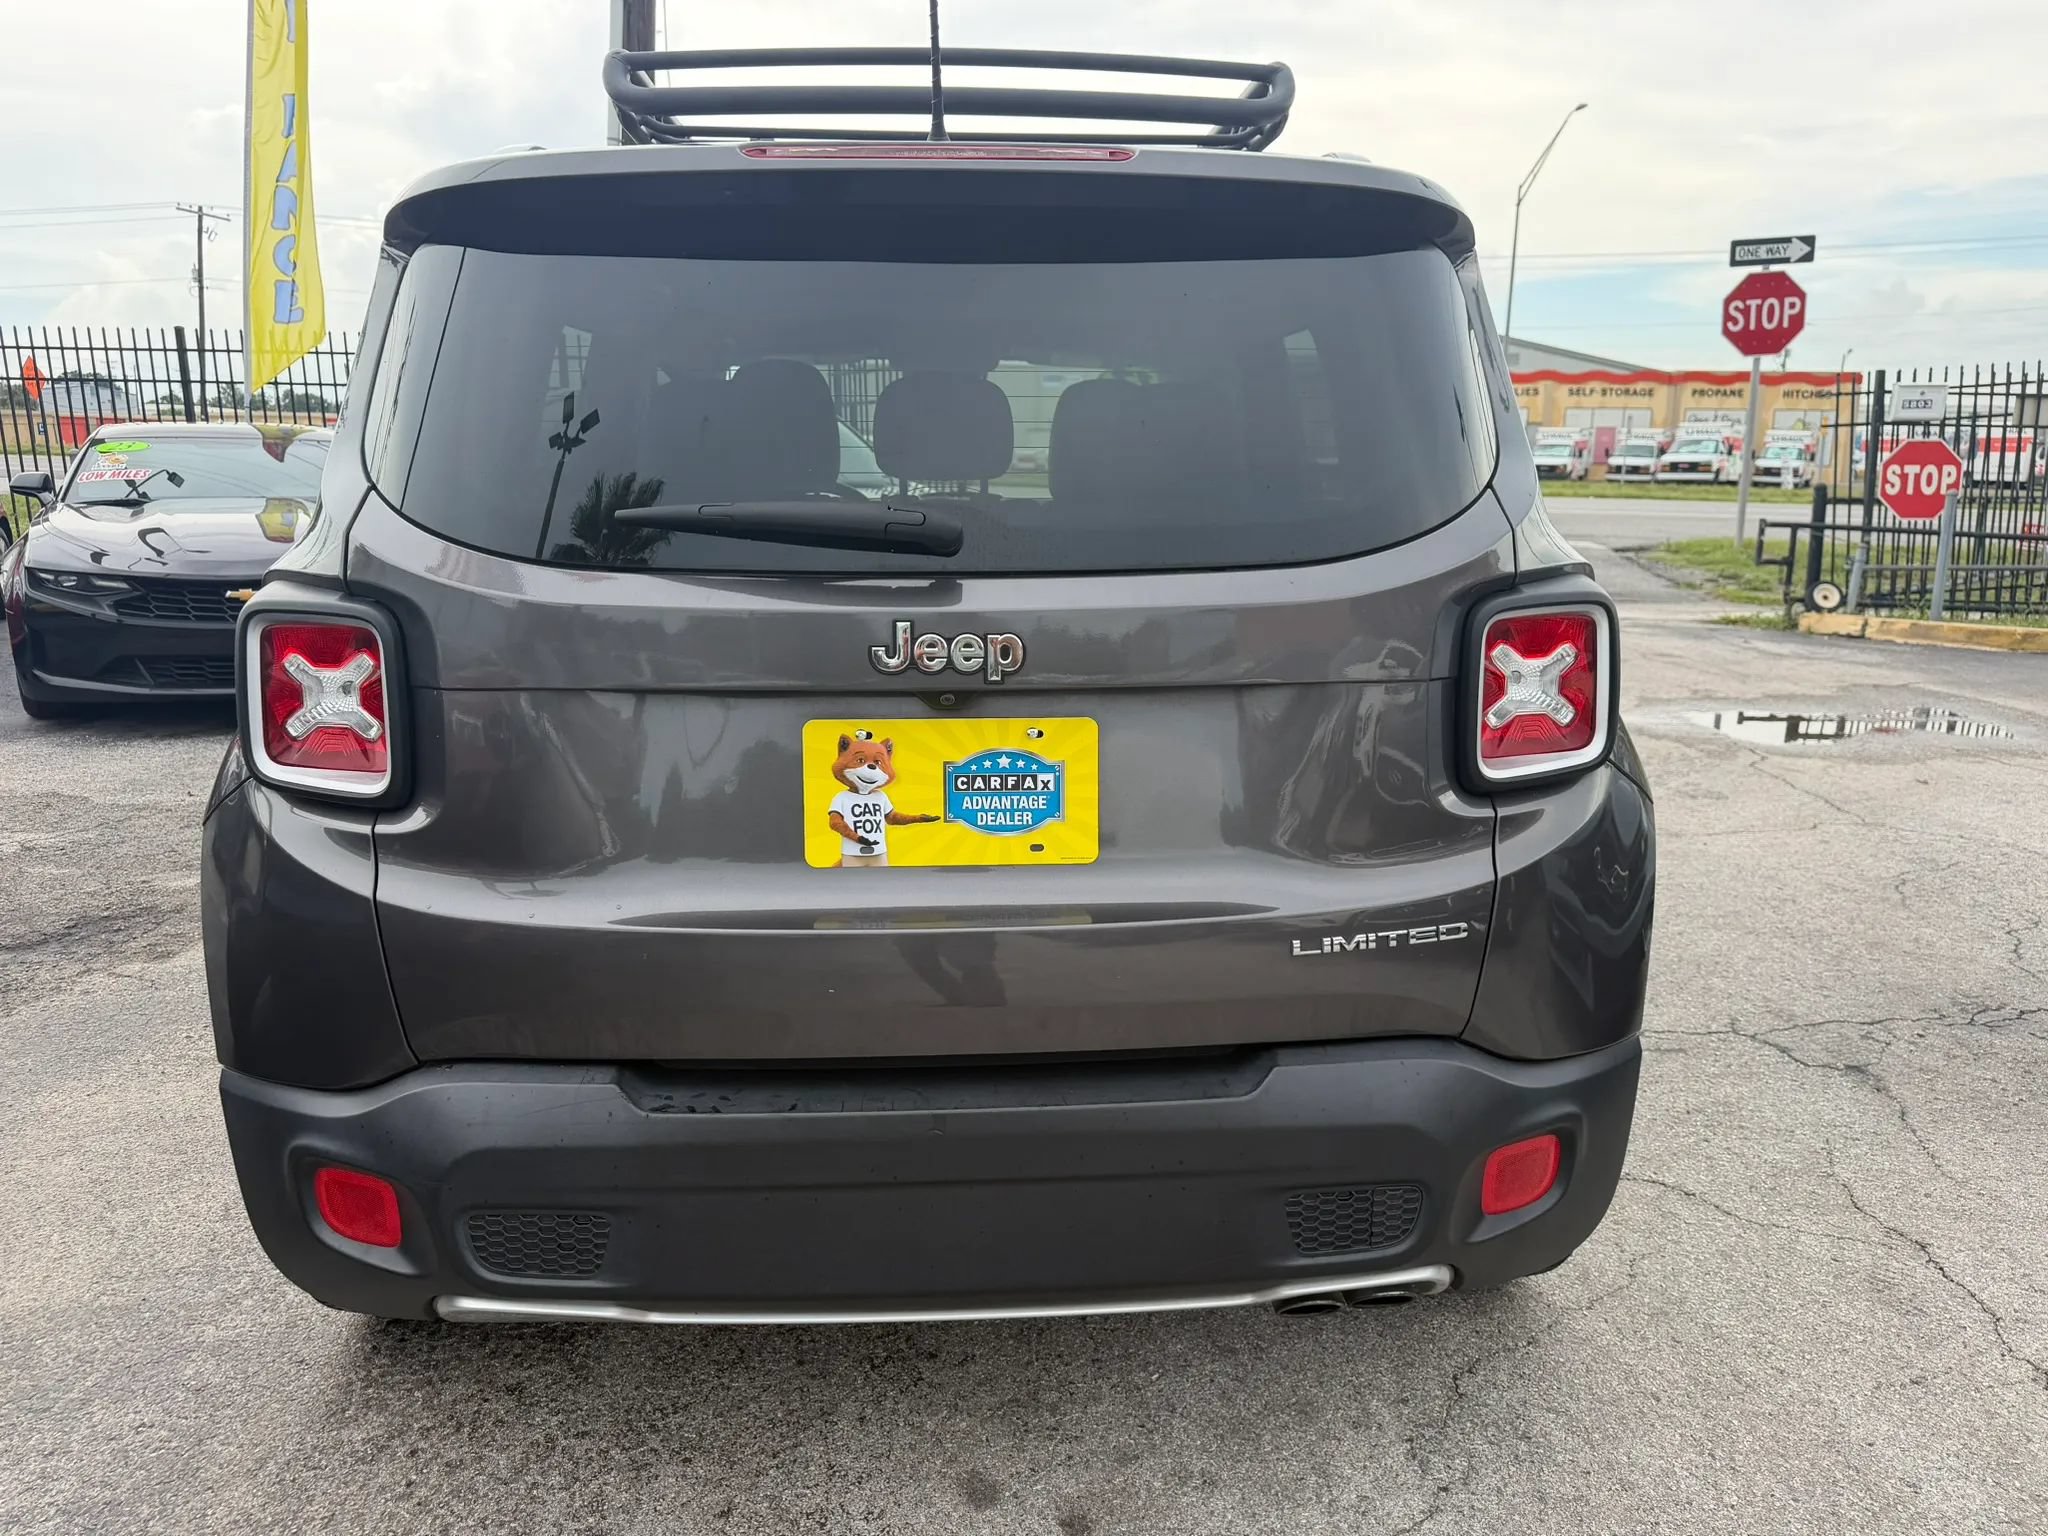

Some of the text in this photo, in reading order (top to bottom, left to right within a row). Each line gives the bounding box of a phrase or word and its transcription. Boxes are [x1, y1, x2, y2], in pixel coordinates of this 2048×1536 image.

[1738, 245, 1789, 259] ONE WAY
[1726, 296, 1801, 333] STOP
[1567, 386, 1655, 398] SELF-STORAGE
[1691, 388, 1745, 398] PROPANE
[79, 469, 149, 481] LOW MILES
[1885, 464, 1958, 496] STOP
[870, 620, 1025, 683] Jeep
[955, 776, 1053, 792] CARFAX
[851, 803, 882, 818] CAR
[962, 796, 1047, 810] ADVANTAGE
[853, 819, 882, 835] FOX
[977, 813, 1032, 826] DEALER
[1291, 921, 1470, 956] LIMITED
